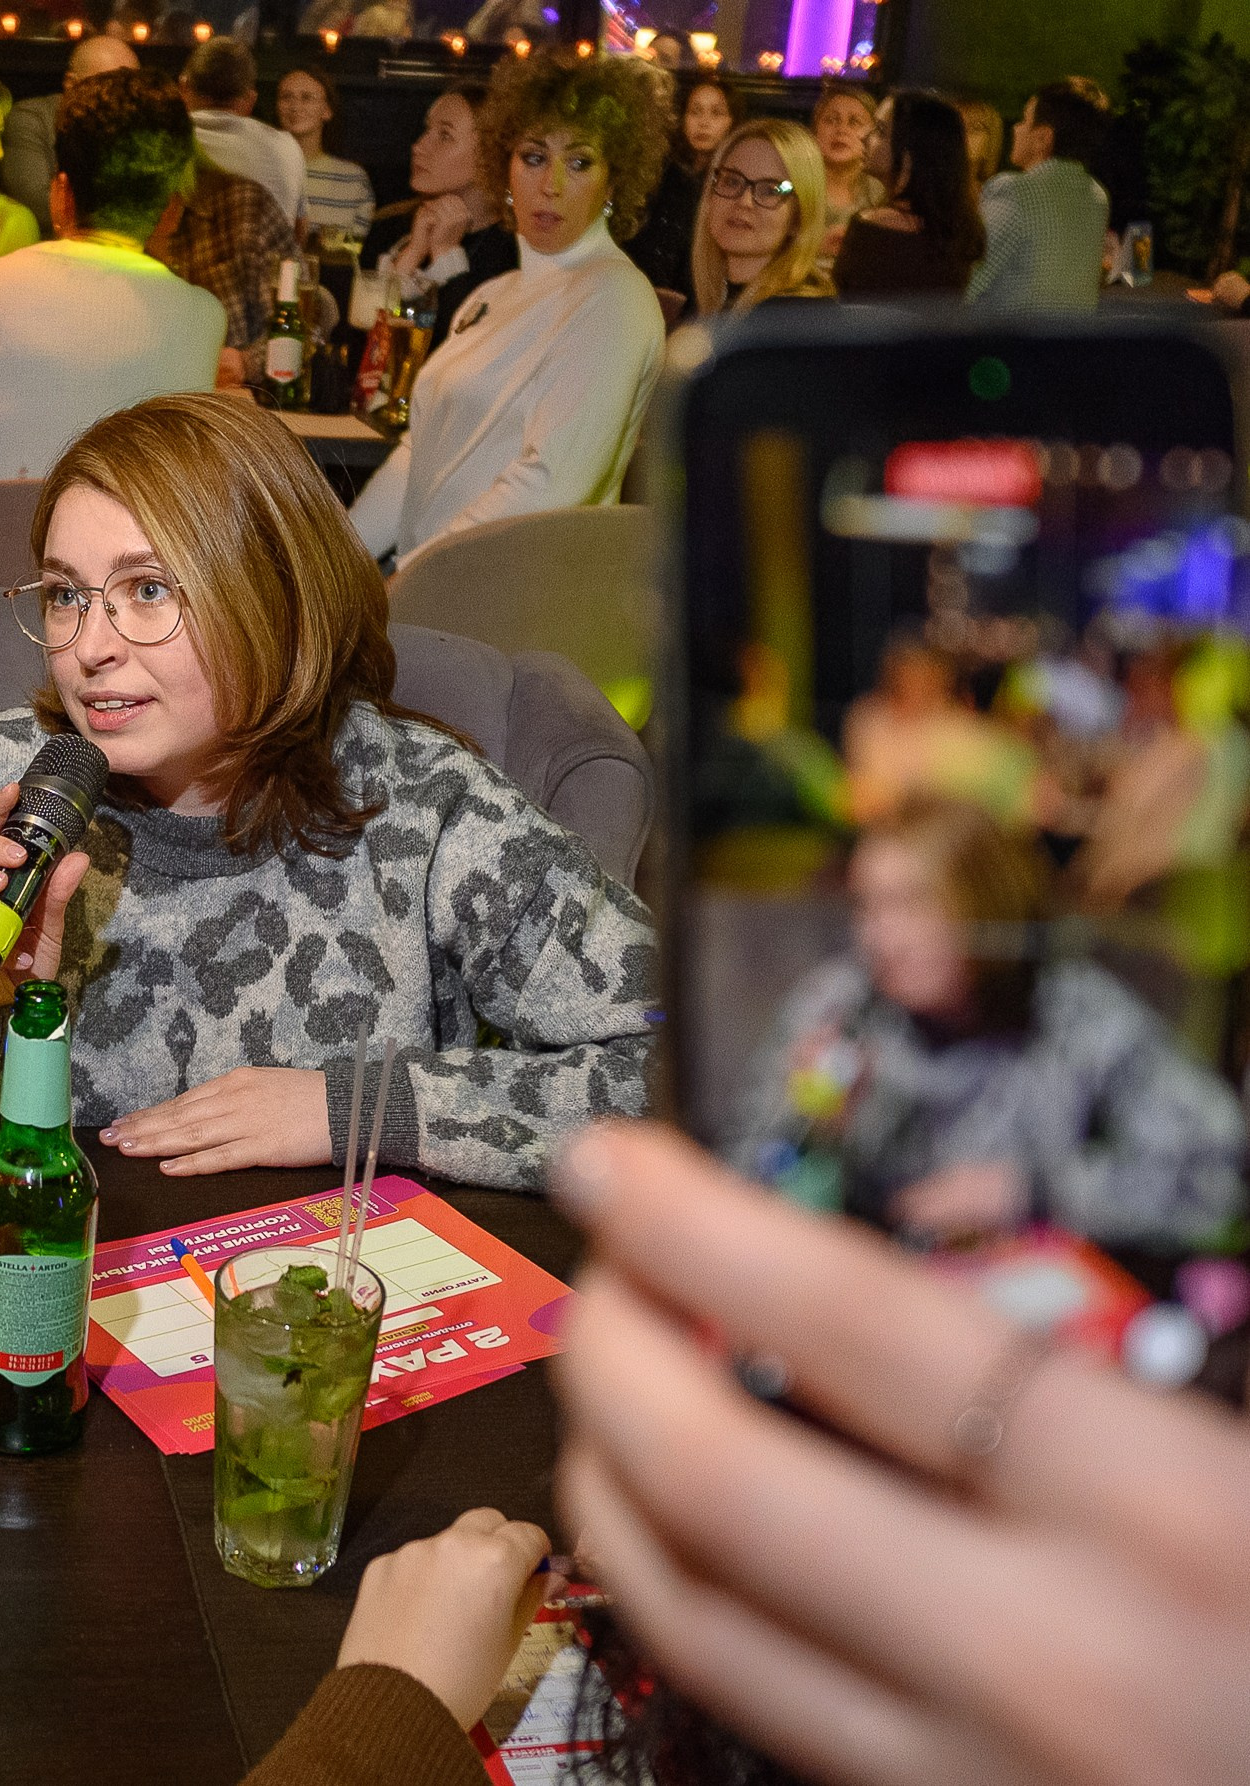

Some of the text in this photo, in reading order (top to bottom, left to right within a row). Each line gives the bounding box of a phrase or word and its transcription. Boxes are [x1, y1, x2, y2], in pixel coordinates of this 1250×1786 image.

[93, 1222, 302, 1282] ЛУЧШИЕ МУЫКАЛЬН
[38, 1261, 68, 1272] ARTOIS
[421, 1275, 489, 1298] КАТЕГОРИЯ
[378, 1324, 427, 1342] НАЗВАН
[190, 1354, 210, 1364] 5
[369, 1325, 511, 1385] 2 РАУ
